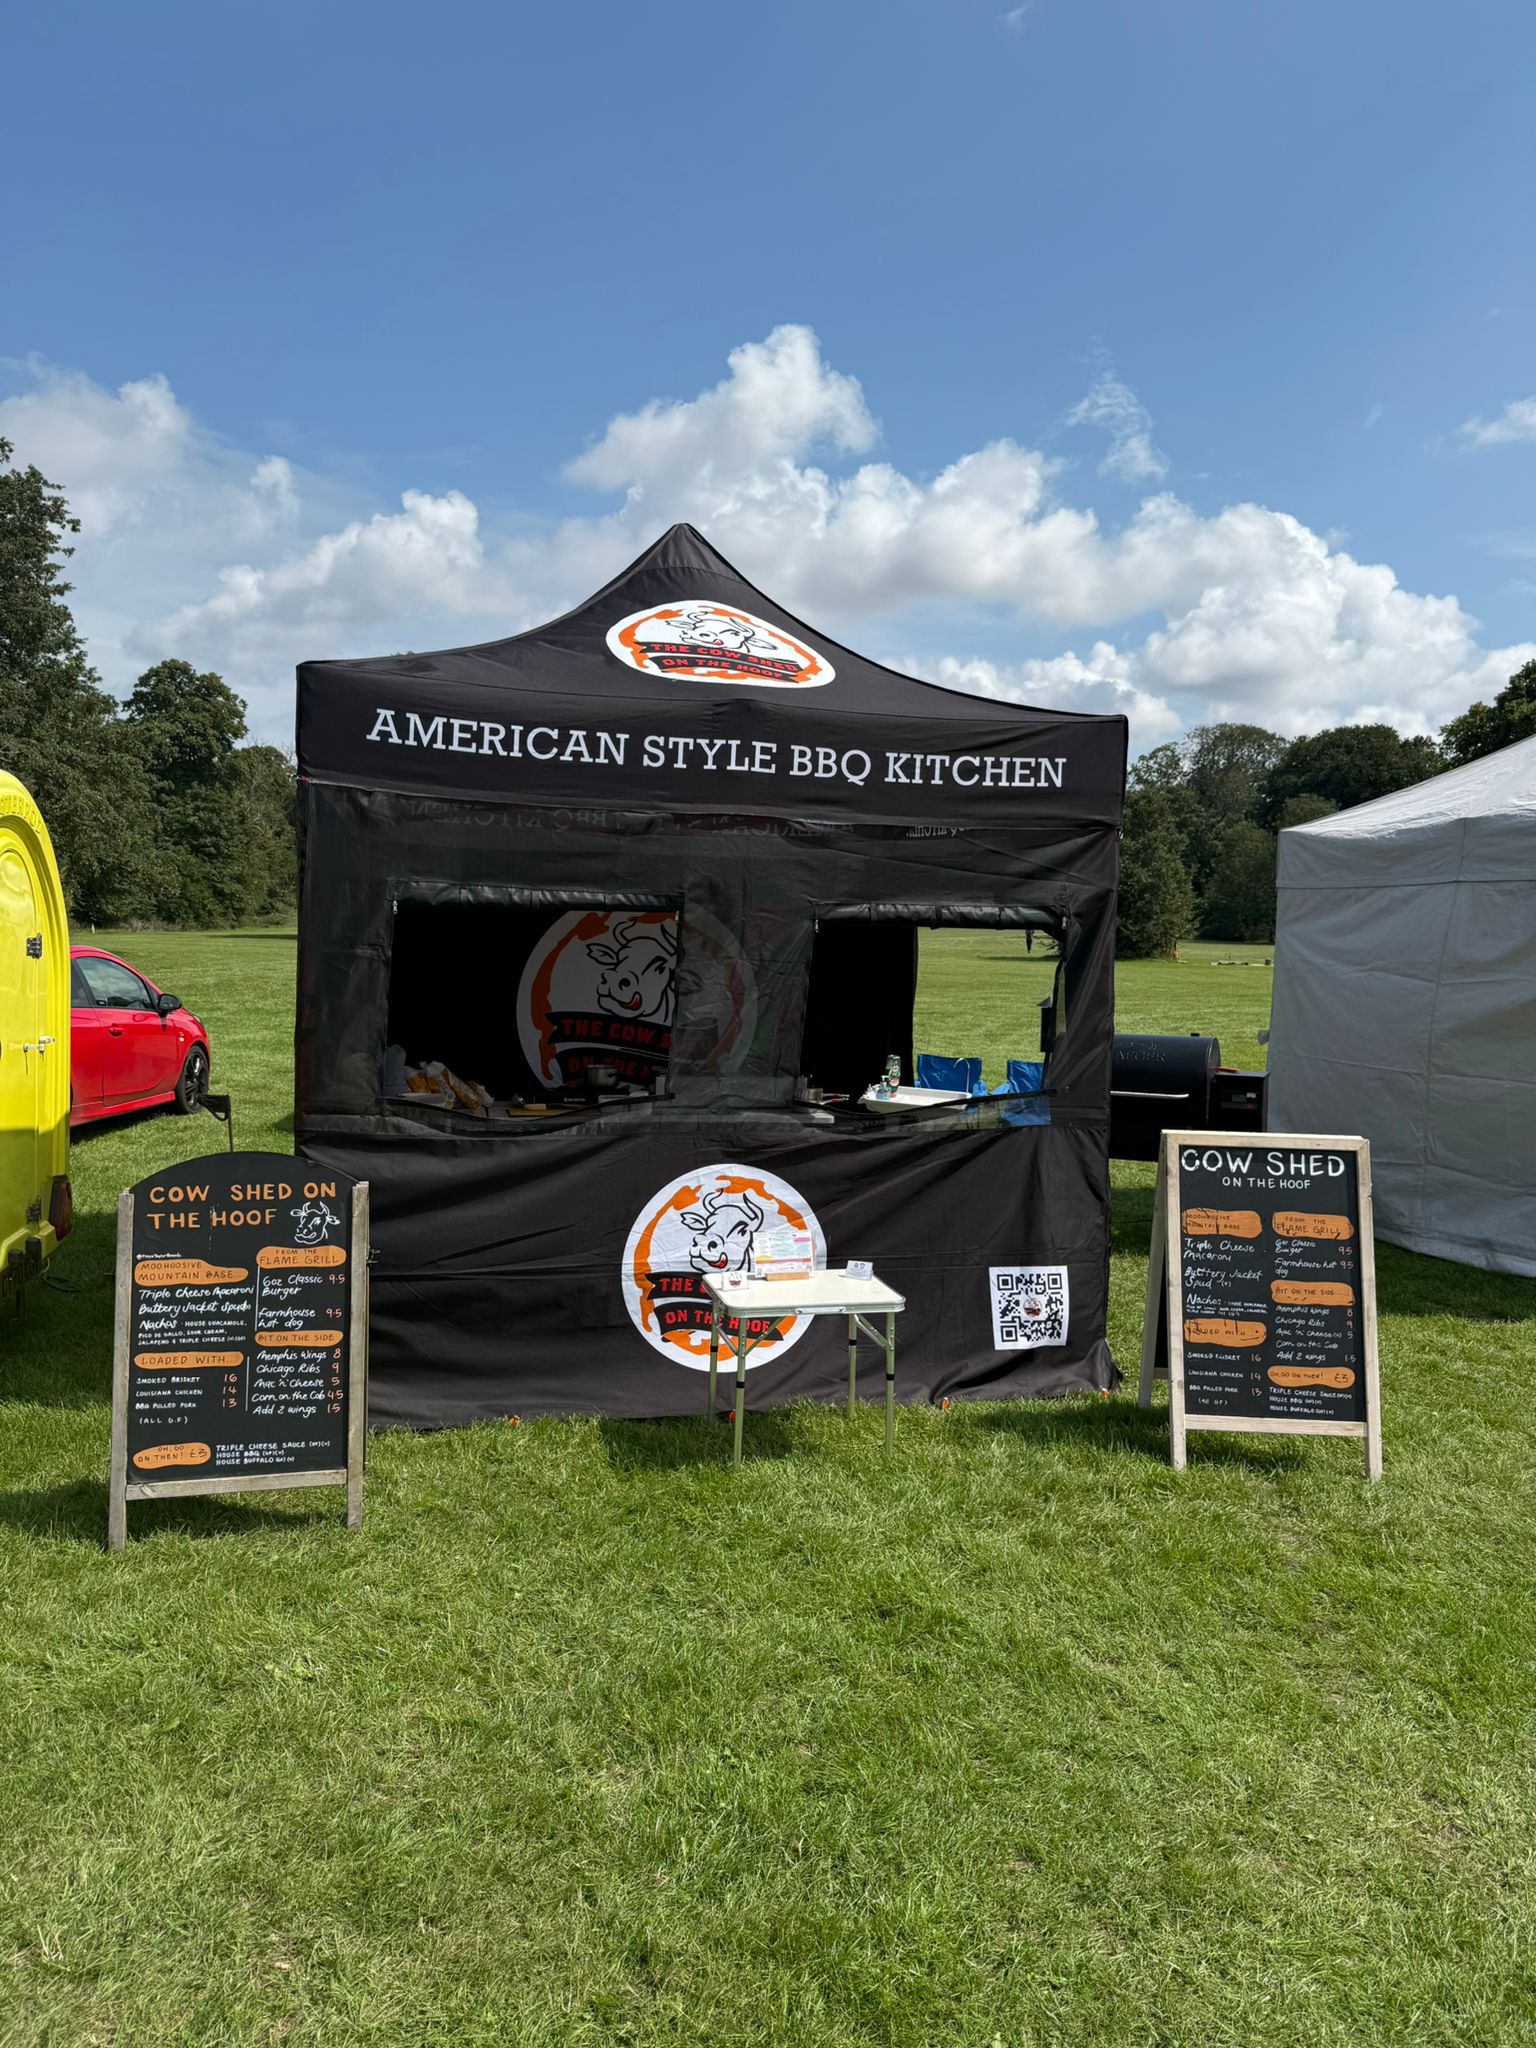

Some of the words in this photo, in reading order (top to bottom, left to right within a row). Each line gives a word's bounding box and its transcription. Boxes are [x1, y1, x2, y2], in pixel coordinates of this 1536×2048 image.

[650, 643, 690, 653] THE
[697, 647, 741, 659] COW
[748, 656, 799, 672] SHED
[661, 658, 689, 667] ON
[695, 659, 734, 668] THE
[736, 665, 784, 679] HOOF
[366, 708, 630, 766] AMERICAN
[642, 735, 777, 775] STYLE
[789, 744, 872, 786] BBQ
[884, 752, 1067, 788] KITCHEN
[561, 1018, 603, 1037] THE
[608, 1022, 657, 1044] COW
[1181, 1149, 1253, 1174] COW
[1266, 1151, 1346, 1177] SHED
[1222, 1176, 1242, 1187] ON
[1247, 1177, 1276, 1188] THE
[1280, 1178, 1312, 1189] HOOF
[150, 1185, 210, 1203] COW
[230, 1183, 293, 1201] SHED
[303, 1182, 336, 1199] ON
[147, 1212, 200, 1229] THE
[212, 1208, 277, 1227] HOOF
[1276, 1223, 1308, 1233] FLAME
[1313, 1225, 1341, 1235] GRILL
[1185, 1238, 1213, 1251] Triple
[1220, 1240, 1255, 1252] Cheese
[260, 1255, 299, 1265] FLAME
[304, 1255, 339, 1264] GRILL
[1183, 1249, 1231, 1261] Macaroni
[139, 1271, 200, 1281] MOUNTAIN
[1184, 1266, 1226, 1283] Buttery
[1229, 1269, 1263, 1281] Jacket
[1275, 1266, 1289, 1278] dog
[263, 1275, 283, 1287] 6oz
[288, 1273, 324, 1285] Classic
[660, 1277, 694, 1292] THE
[1185, 1275, 1212, 1289] Spud
[139, 1288, 171, 1301] Triple
[175, 1286, 211, 1298] Cheese
[212, 1285, 255, 1299] Macaroni
[262, 1286, 302, 1300] Burger
[139, 1303, 181, 1318] Buttery
[182, 1301, 219, 1314] Jacket
[1346, 1309, 1353, 1317] 8
[139, 1317, 178, 1331] Nachos
[258, 1318, 279, 1328] hot
[284, 1317, 303, 1330] dog
[665, 1310, 687, 1324] ON
[728, 1315, 770, 1334] HOF
[1275, 1316, 1306, 1328] Chicago
[1308, 1318, 1325, 1327] Ribs
[1346, 1320, 1353, 1329] 9
[314, 1333, 335, 1341] SIDE
[141, 1355, 188, 1366] LOADED
[257, 1349, 298, 1363] Memphis
[333, 1348, 341, 1359] 8
[1251, 1354, 1261, 1362] 16
[1277, 1350, 1294, 1361] Add
[1296, 1352, 1302, 1361] 2
[256, 1364, 295, 1377] Chicago
[298, 1363, 320, 1373] Ribs
[332, 1362, 339, 1373] 9
[224, 1373, 238, 1383] 16
[254, 1378, 276, 1388] Mac
[289, 1379, 324, 1388] Cheese
[331, 1376, 340, 1385] 5
[1250, 1372, 1261, 1381] 14
[135, 1389, 172, 1397] LOUISIANA
[175, 1388, 203, 1396] CHICKEN
[223, 1386, 237, 1395] 14
[251, 1393, 278, 1402] Corn
[291, 1391, 308, 1400] the
[309, 1389, 326, 1400] Cob
[1251, 1388, 1262, 1396] 13
[1269, 1386, 1292, 1395] TRIPLE
[135, 1402, 150, 1410] BBQ
[222, 1398, 238, 1408] 13
[252, 1404, 275, 1415] Add
[277, 1405, 285, 1414] 2
[288, 1405, 317, 1418] wings
[216, 1444, 244, 1452] TRIPLE
[155, 1451, 183, 1460] THEN!
[216, 1451, 240, 1459] HOUSE
[216, 1458, 241, 1466] HOUSE
